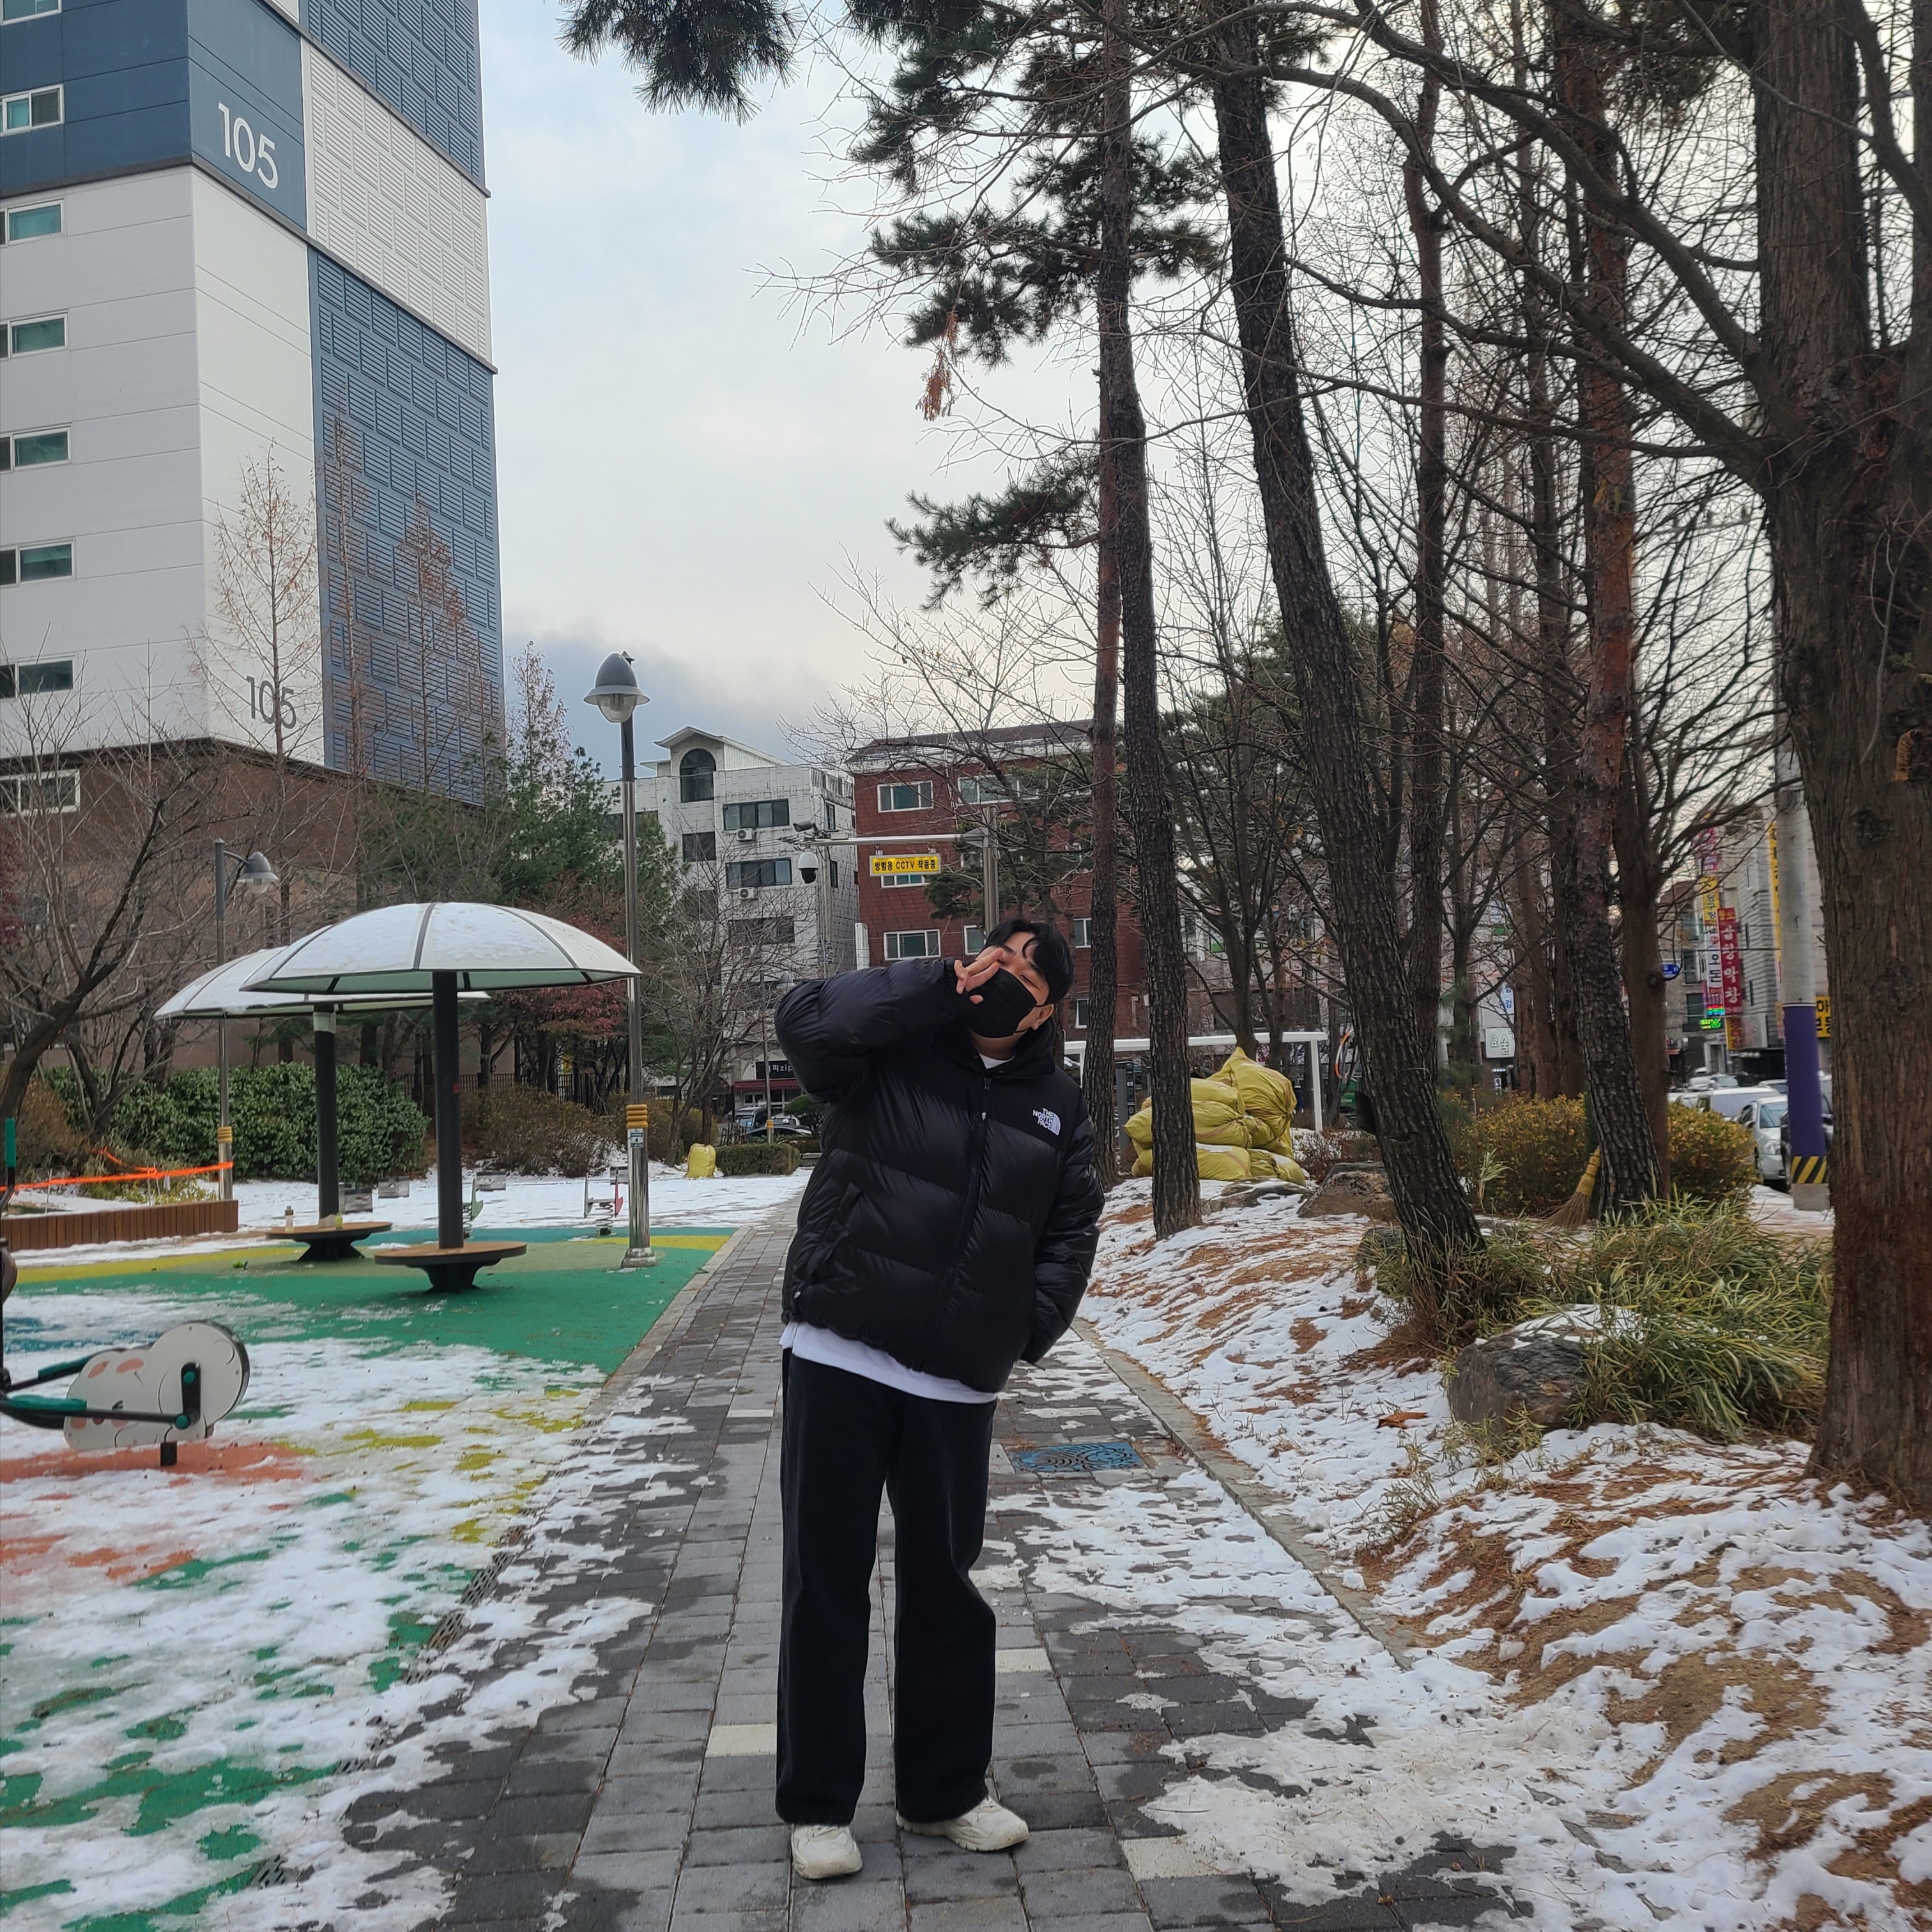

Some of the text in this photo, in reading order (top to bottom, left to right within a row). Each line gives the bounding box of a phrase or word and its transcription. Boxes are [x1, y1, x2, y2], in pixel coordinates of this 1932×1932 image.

[218, 102, 279, 189] 105
[246, 675, 297, 729] 105
[875, 859, 936, 871] 방범용 CCTV 작동중
[1032, 1109, 1053, 1124] NORTH
[1042, 1107, 1054, 1119] THE
[1037, 1117, 1052, 1131] FACE
